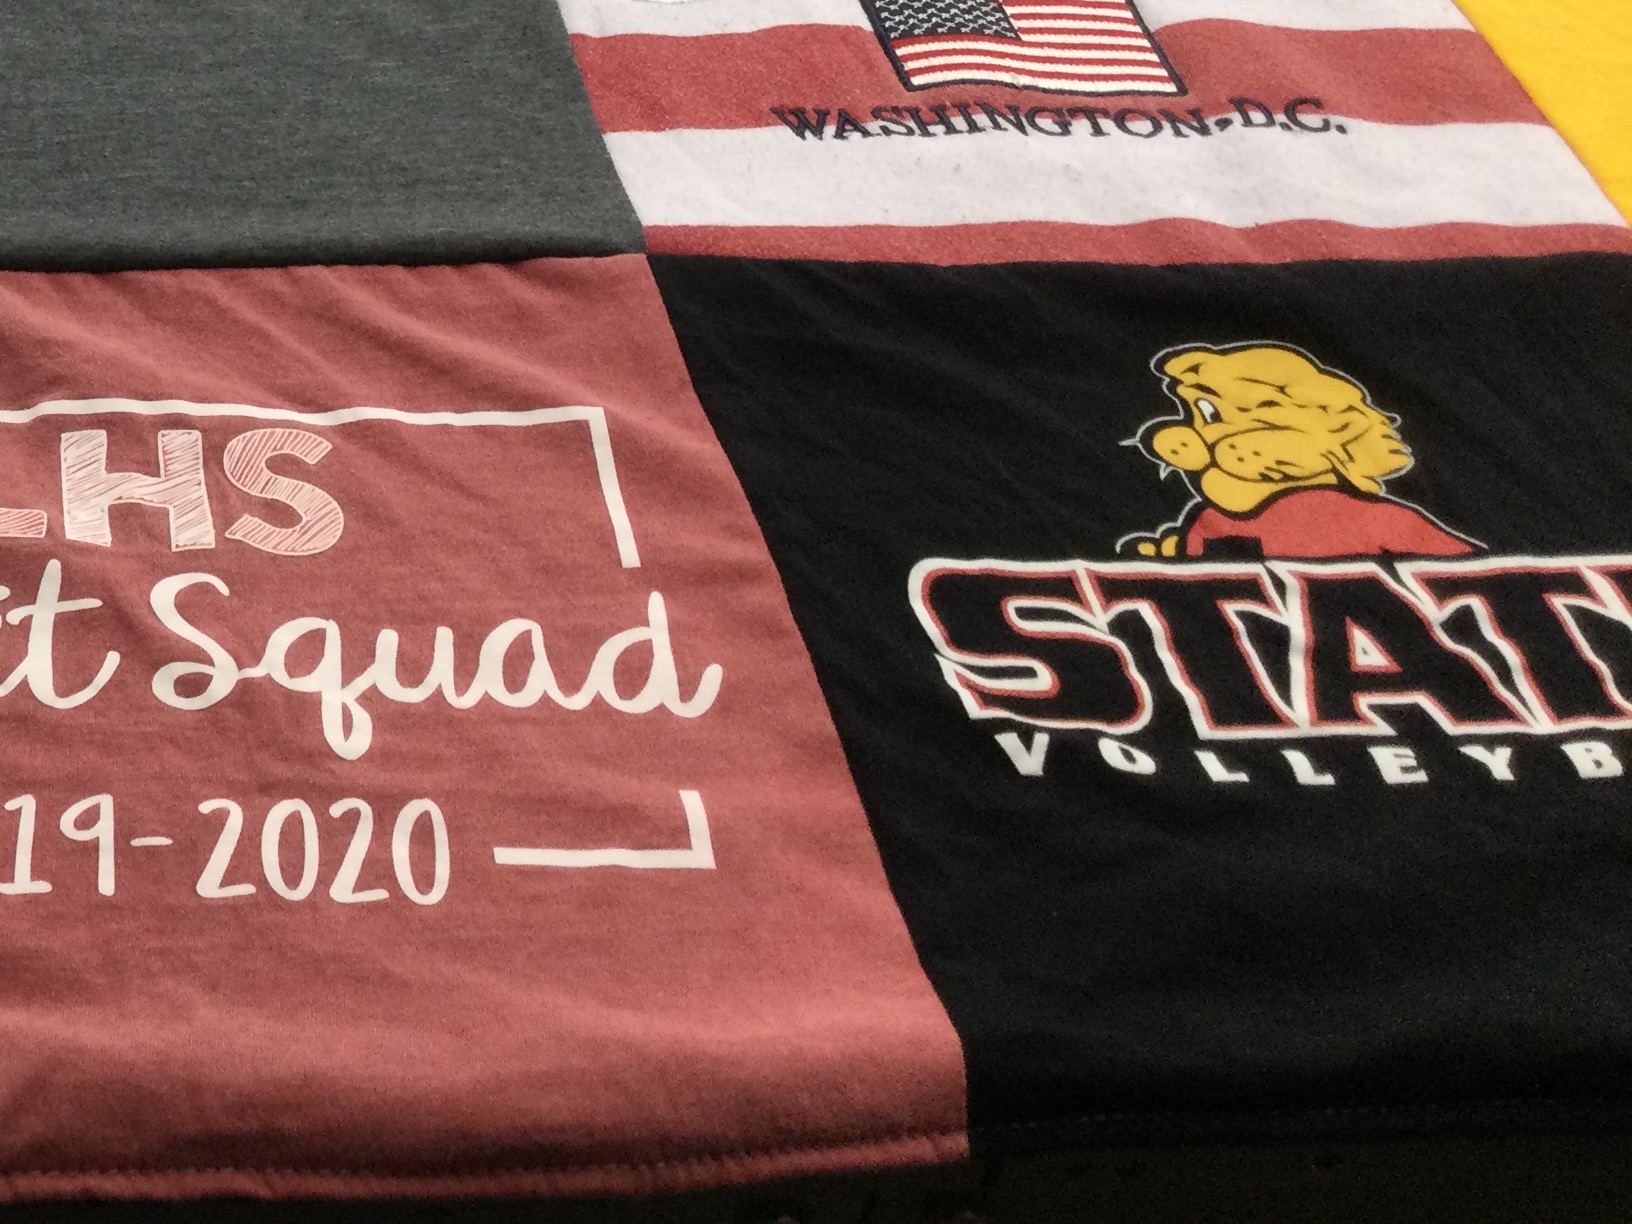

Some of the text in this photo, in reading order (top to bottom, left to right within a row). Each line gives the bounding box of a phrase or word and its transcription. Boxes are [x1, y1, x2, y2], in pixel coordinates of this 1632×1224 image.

[148, 571, 725, 762] Squad
[907, 553, 1632, 742] STAT
[993, 730, 1626, 788] VOLLEYB
